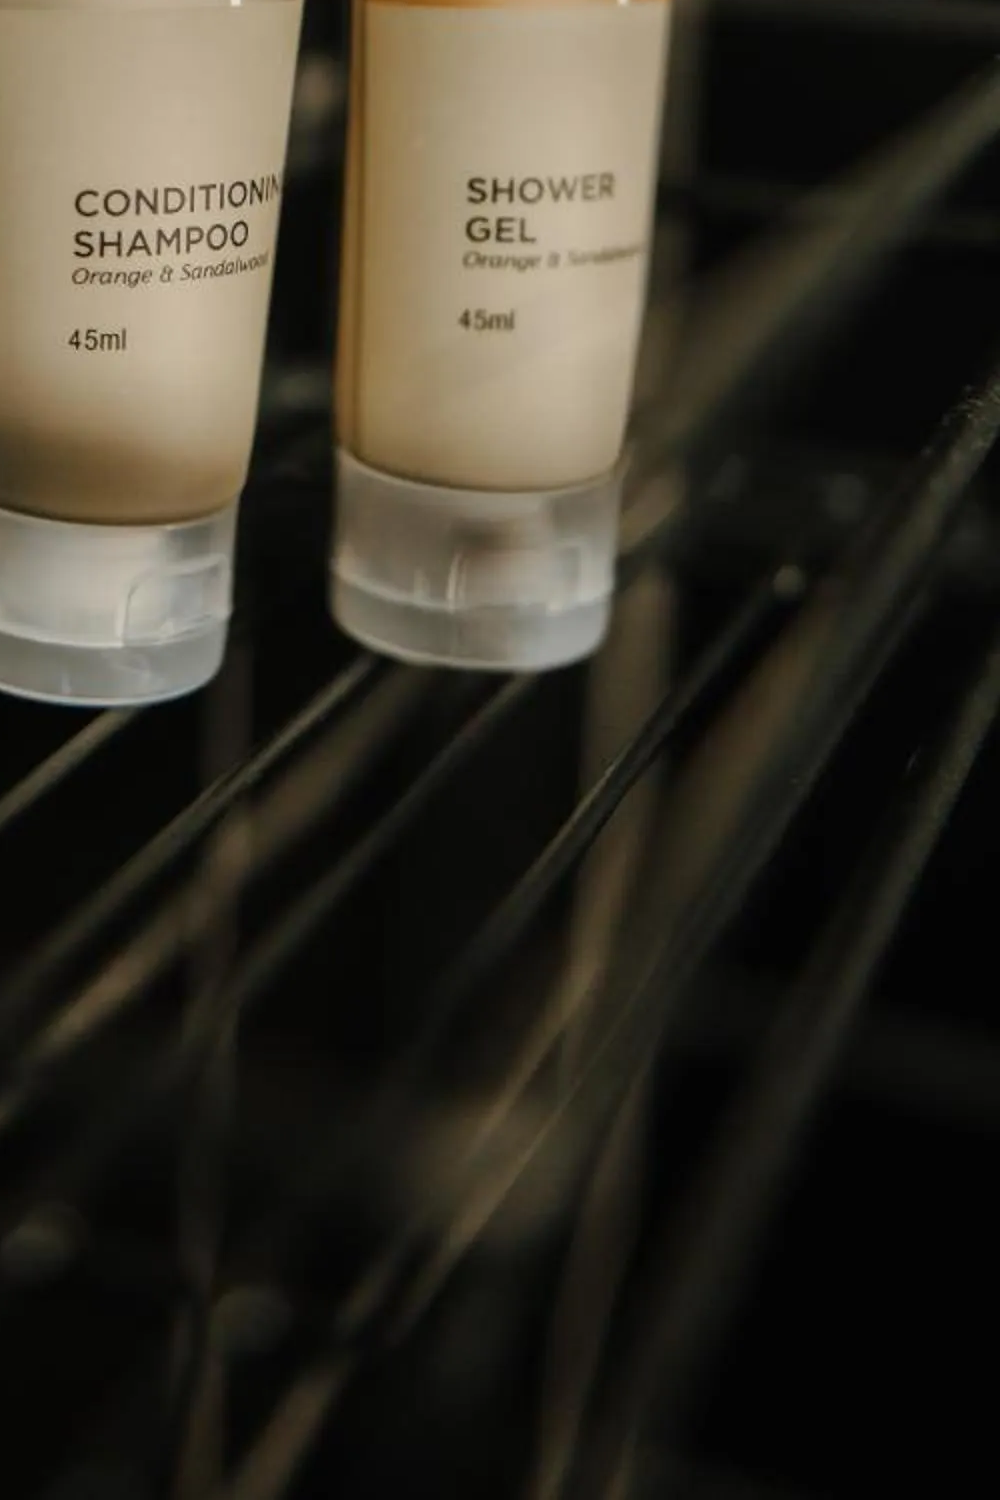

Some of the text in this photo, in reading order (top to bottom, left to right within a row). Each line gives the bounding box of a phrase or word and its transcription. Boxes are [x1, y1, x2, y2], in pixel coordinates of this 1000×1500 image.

[466, 172, 616, 205] SHOWER
[72, 220, 249, 259] SHAMPOO
[464, 216, 537, 244] GEL
[462, 250, 541, 273] Orange
[71, 266, 153, 289] Orange
[160, 264, 174, 284] &
[458, 308, 516, 332] 45ml
[68, 328, 127, 352] 45ml
